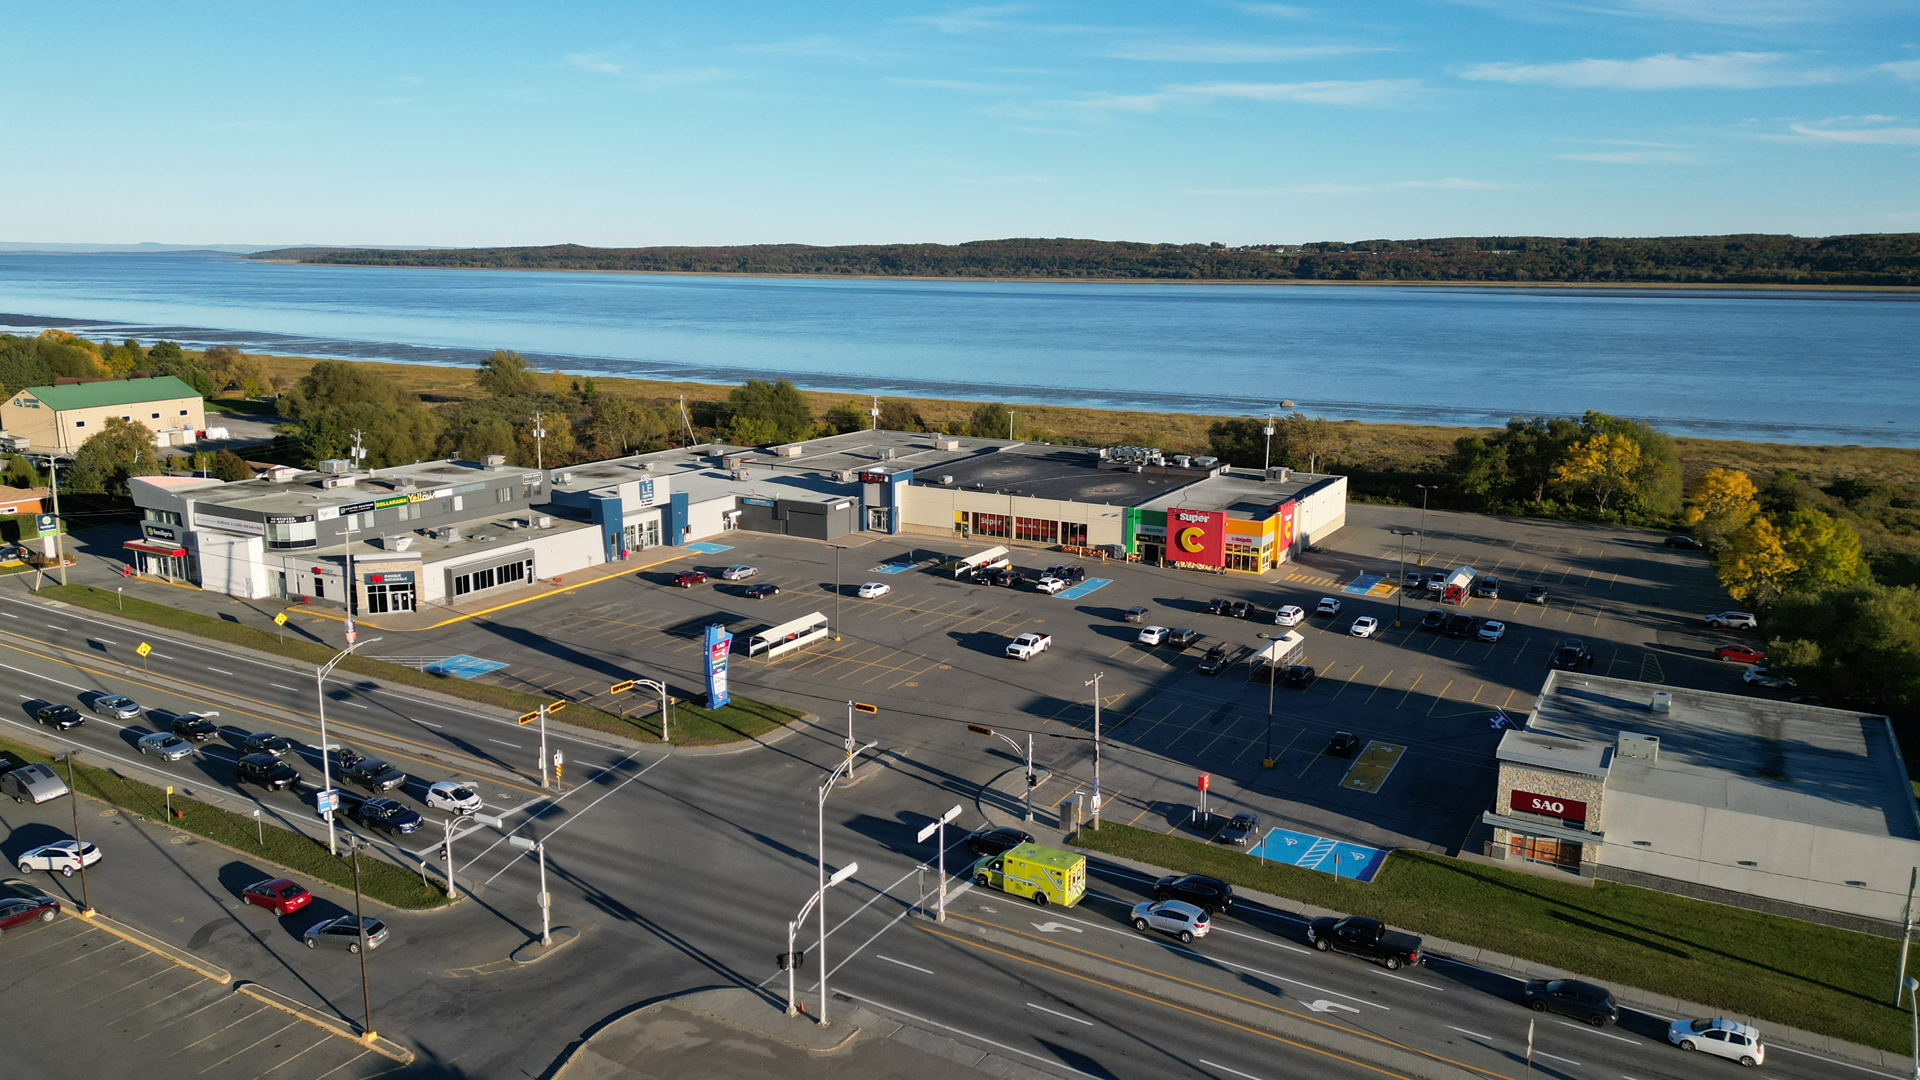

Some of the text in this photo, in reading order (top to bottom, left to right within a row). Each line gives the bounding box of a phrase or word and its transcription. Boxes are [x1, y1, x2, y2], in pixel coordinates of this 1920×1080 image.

[861, 473, 887, 484] Hart
[641, 484, 653, 494] LE
[376, 498, 407, 507] DOLLARAMA
[408, 491, 435, 503] Yellow
[1180, 513, 1209, 523] Super
[1181, 527, 1205, 553] C
[1532, 798, 1564, 814] SAQ
